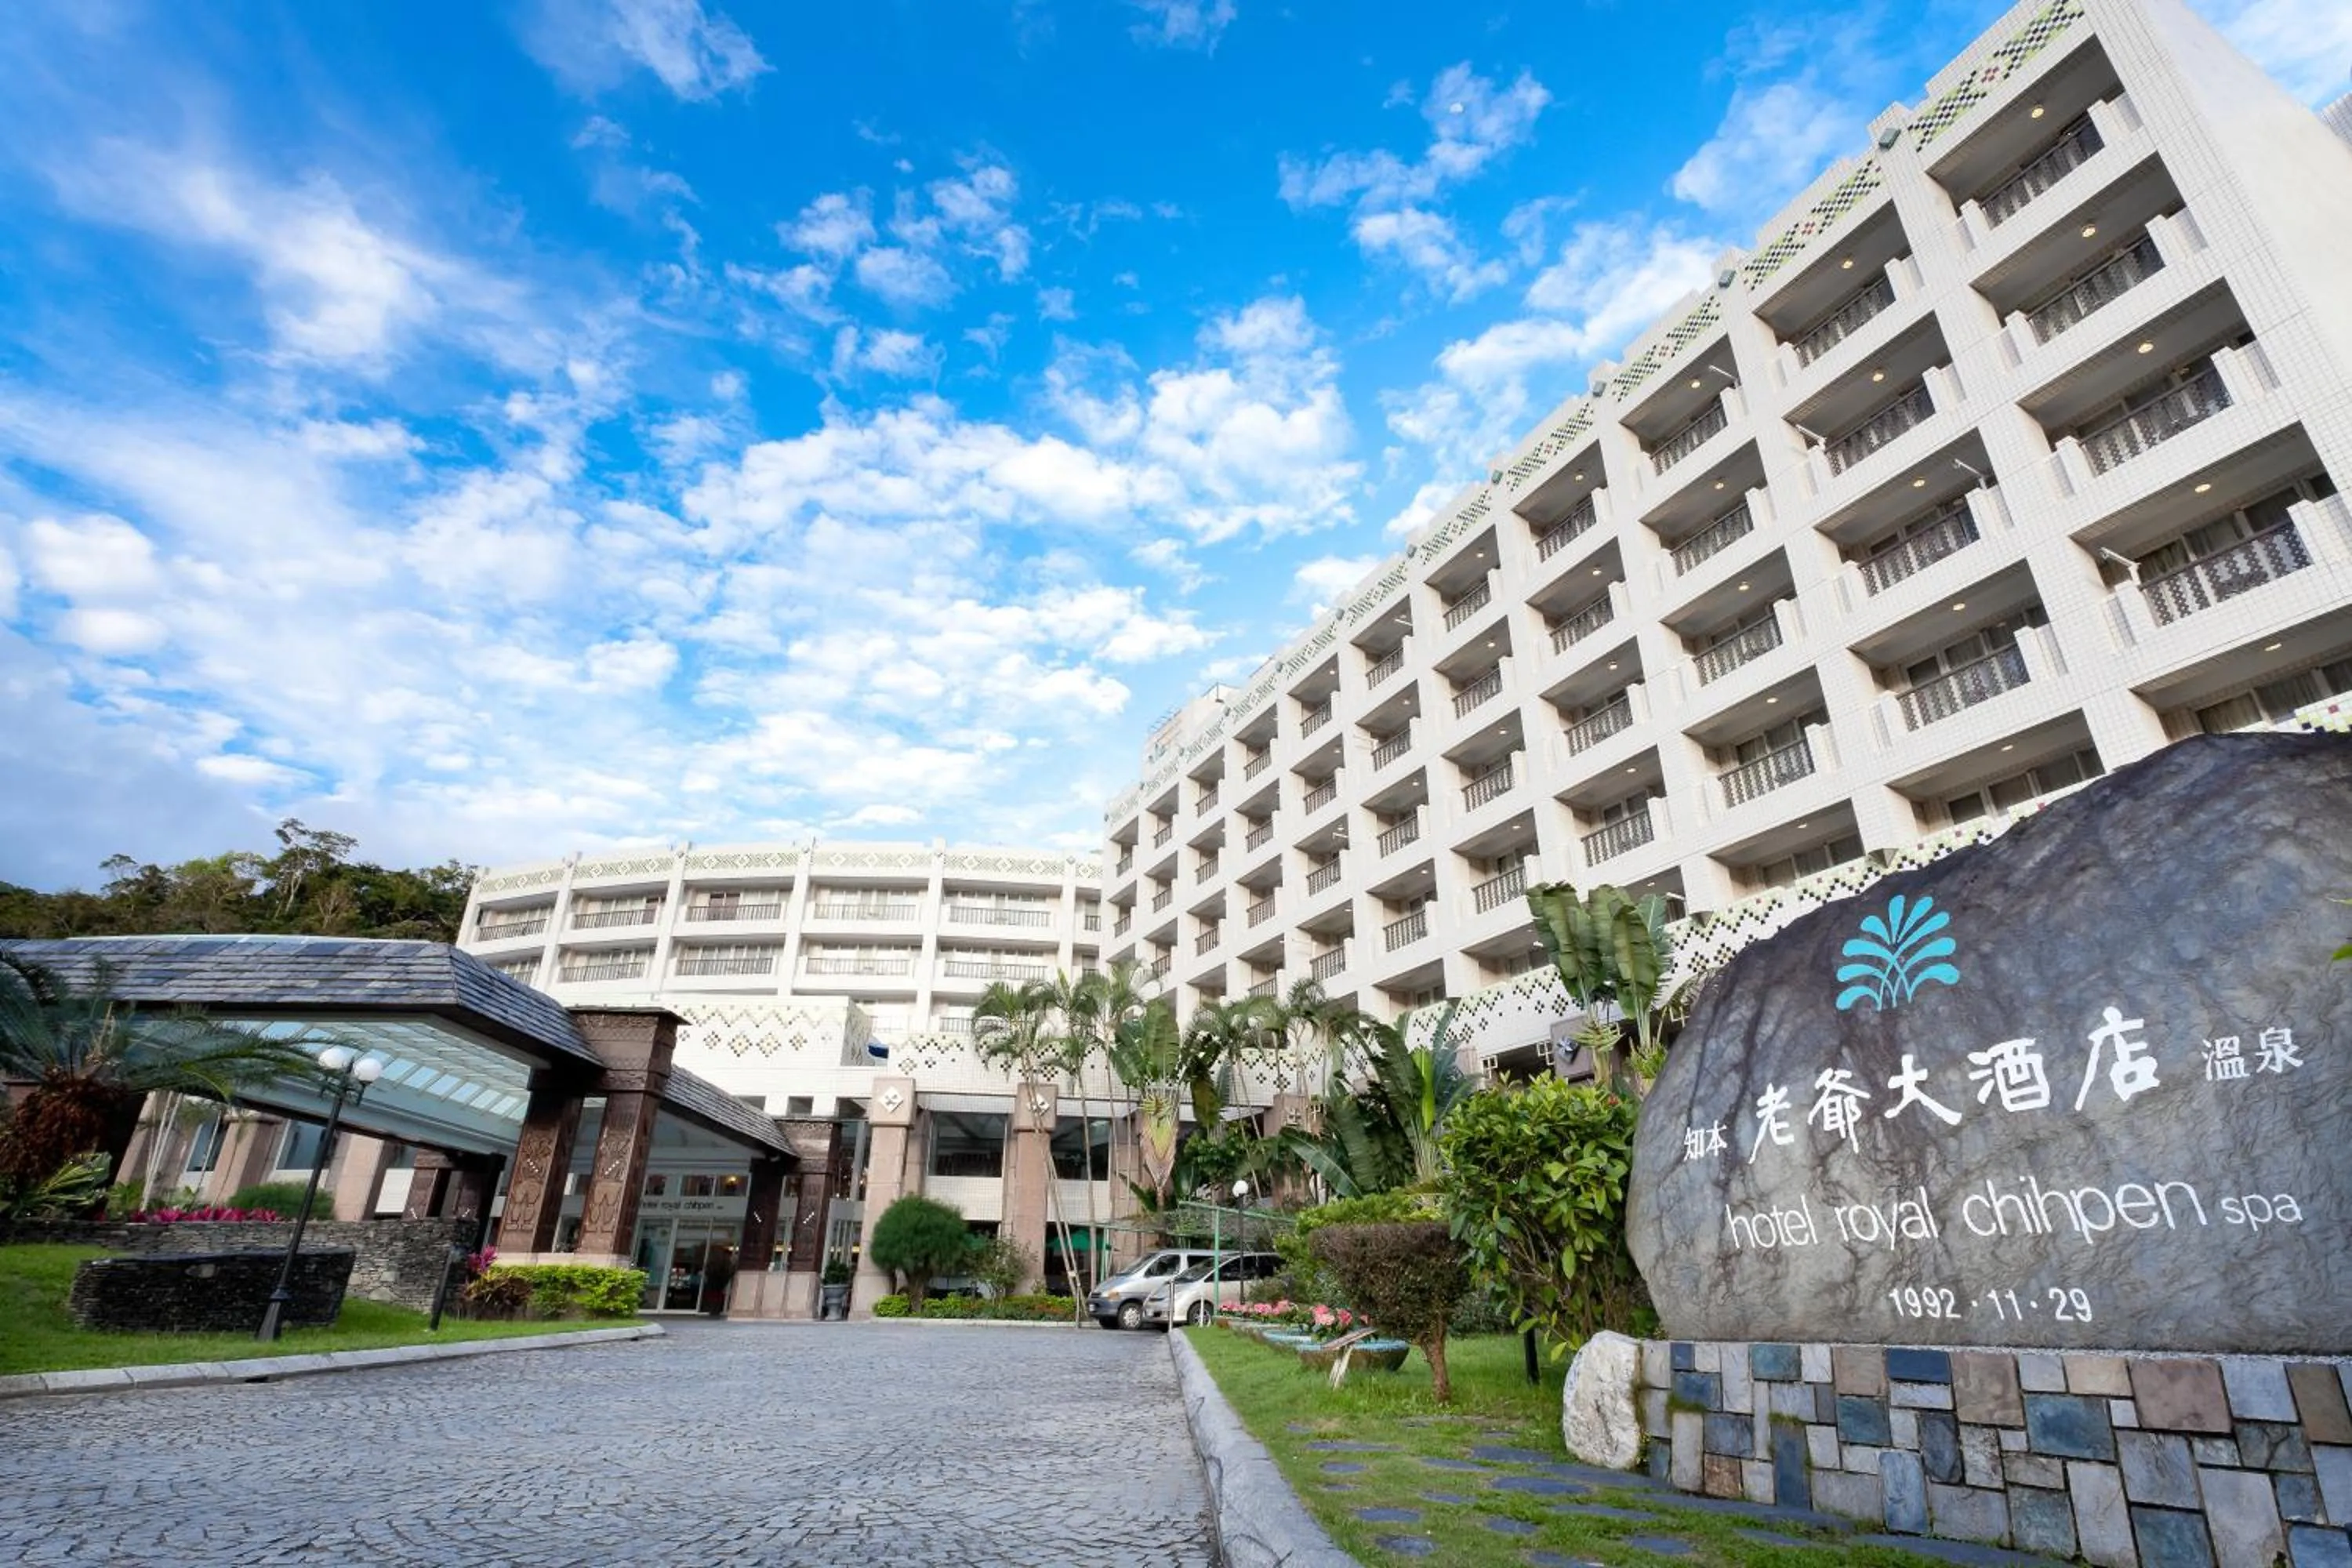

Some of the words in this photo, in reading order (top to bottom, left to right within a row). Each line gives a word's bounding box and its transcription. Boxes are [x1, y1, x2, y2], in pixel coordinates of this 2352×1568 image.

[1683, 1120, 1728, 1162] 知本
[1748, 1006, 2161, 1164] 老爺大酒店
[2201, 1026, 2304, 1081] 溫泉
[1726, 1195, 1818, 1249] hotel
[1832, 1186, 1939, 1251] royal
[1962, 1175, 2208, 1245] chihpen
[2221, 1194, 2303, 1232] spa
